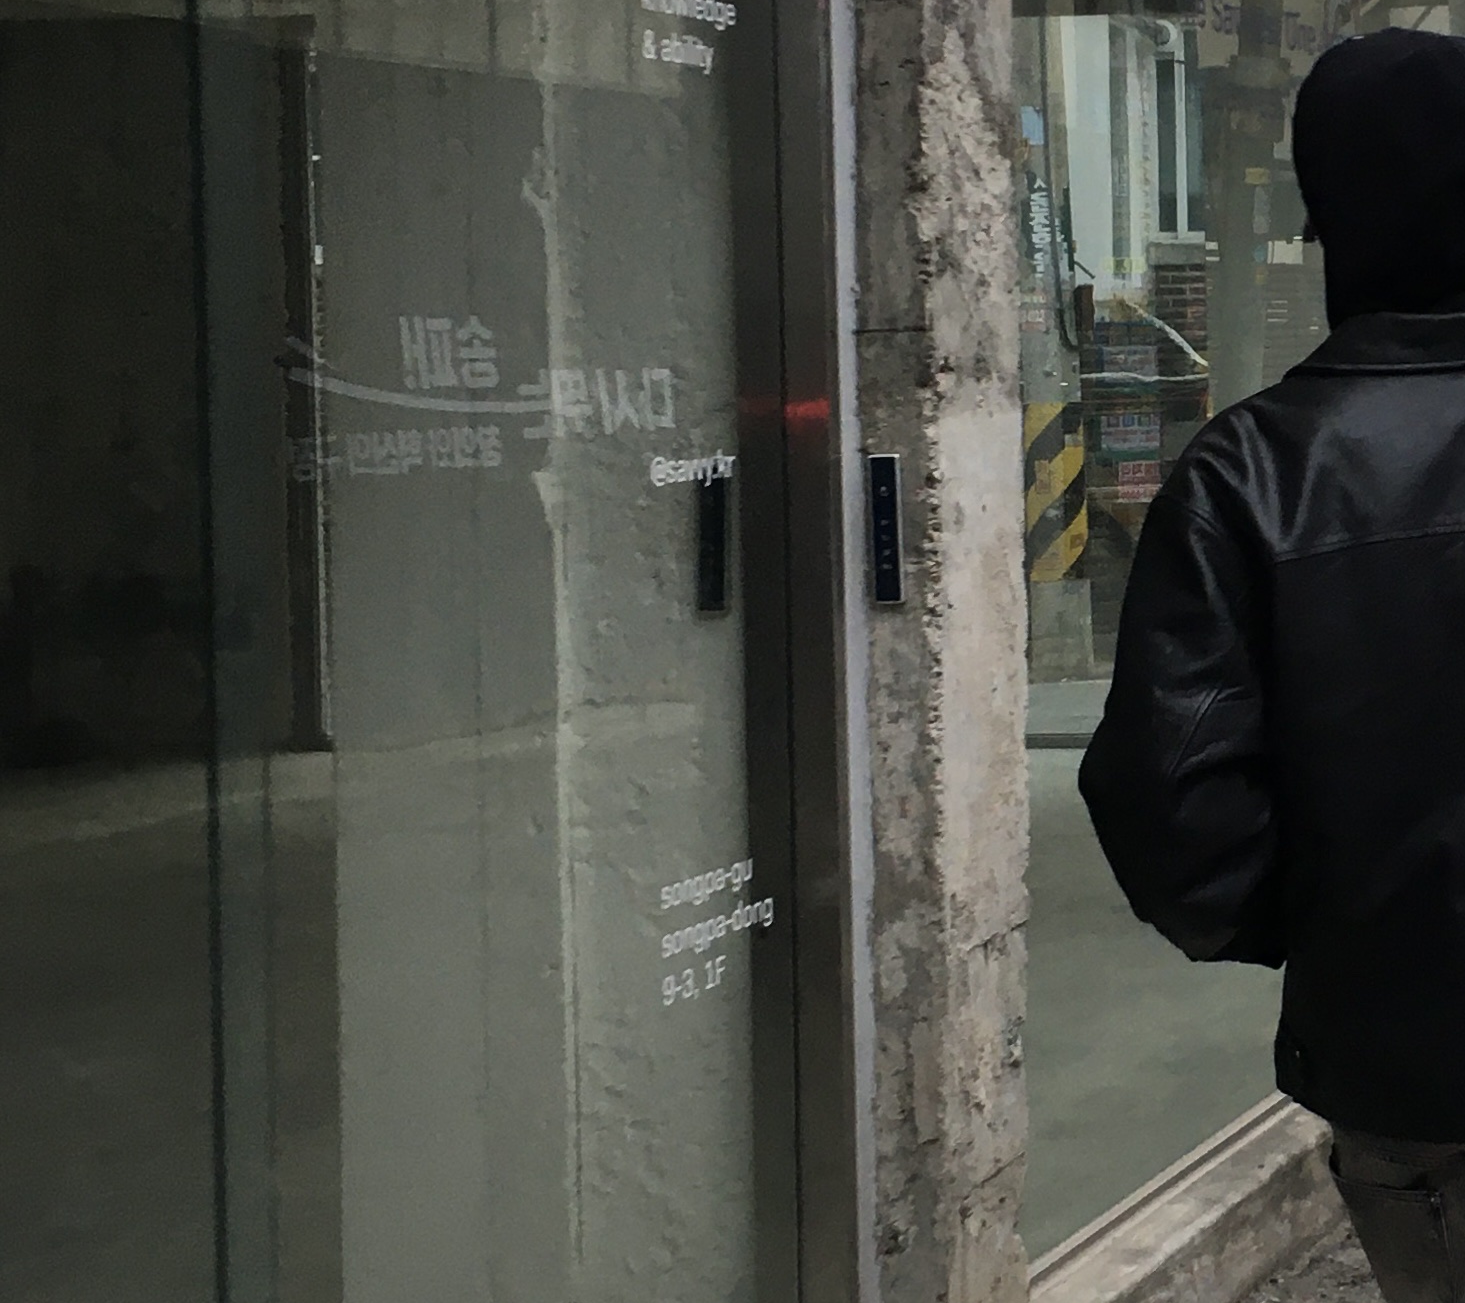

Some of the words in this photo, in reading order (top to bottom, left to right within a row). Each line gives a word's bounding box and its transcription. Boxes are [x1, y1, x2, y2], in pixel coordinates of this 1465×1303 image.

[660, 857, 753, 909] songpa-gu
[661, 897, 774, 959] songpa-dong
[661, 968, 700, 1006] 9-3,
[705, 955, 727, 990] 1F
